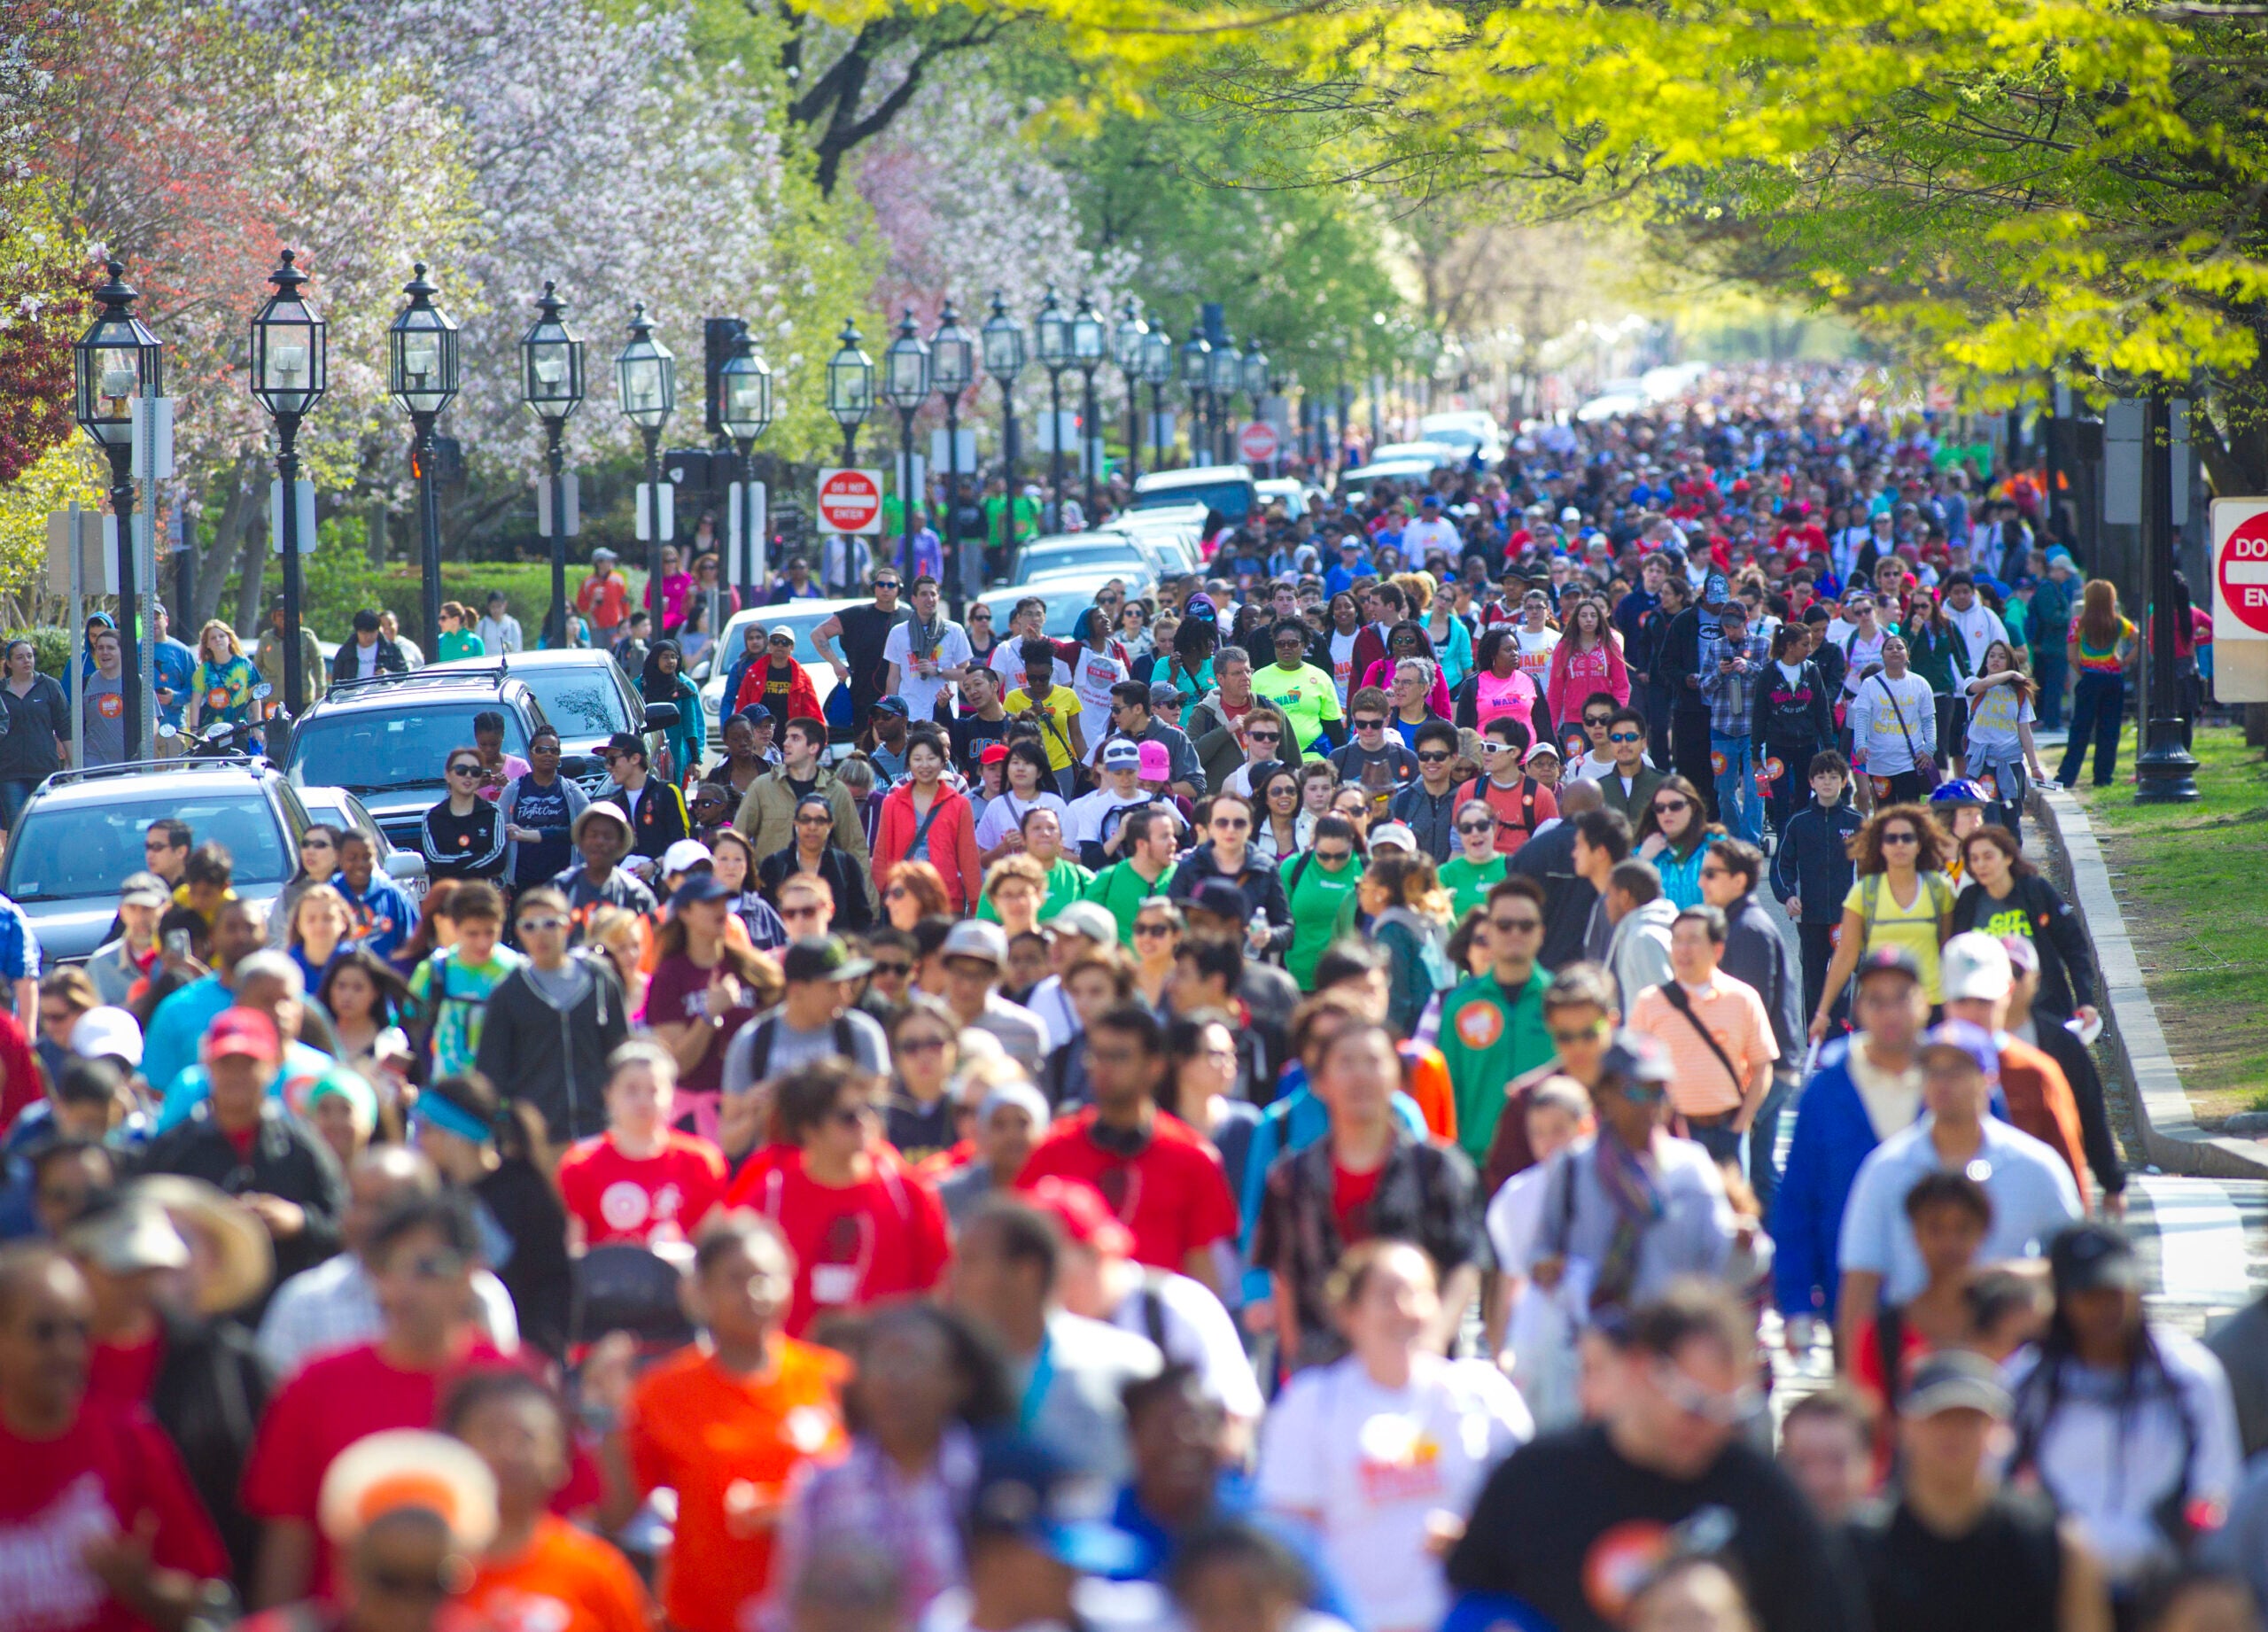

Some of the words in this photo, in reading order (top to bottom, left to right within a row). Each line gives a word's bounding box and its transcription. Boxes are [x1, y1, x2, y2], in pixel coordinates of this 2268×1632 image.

[831, 482, 846, 493] DO
[848, 482, 867, 493] NOT
[833, 508, 866, 520] ENTER
[2235, 538, 2268, 558] DO
[1492, 697, 1520, 707] WALK
[517, 803, 542, 820] Flight
